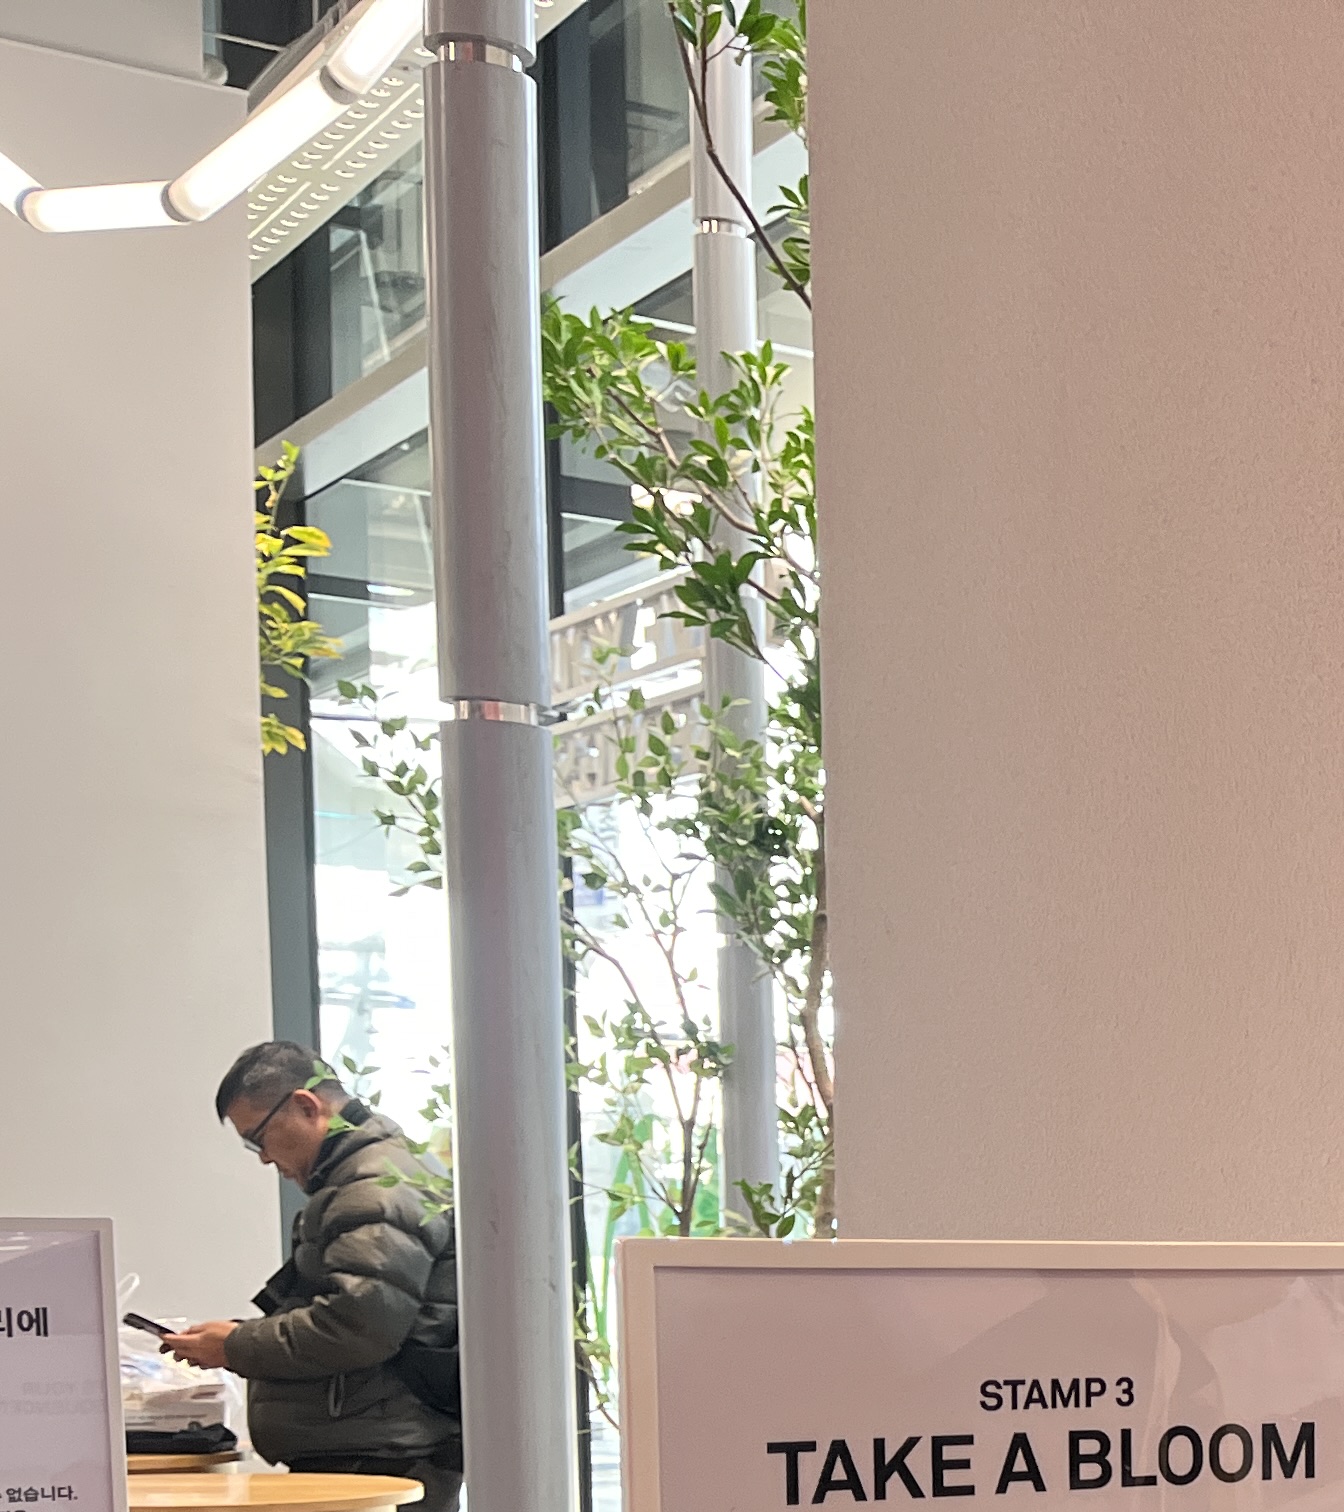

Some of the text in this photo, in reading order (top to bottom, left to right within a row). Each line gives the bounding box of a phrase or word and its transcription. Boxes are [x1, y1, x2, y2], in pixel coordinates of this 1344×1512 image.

[979, 1376, 1135, 1412] STAMP 3
[766, 1421, 1315, 1506] TAKE A BLOOM
[5, 1485, 79, 1503] 없습니다.
